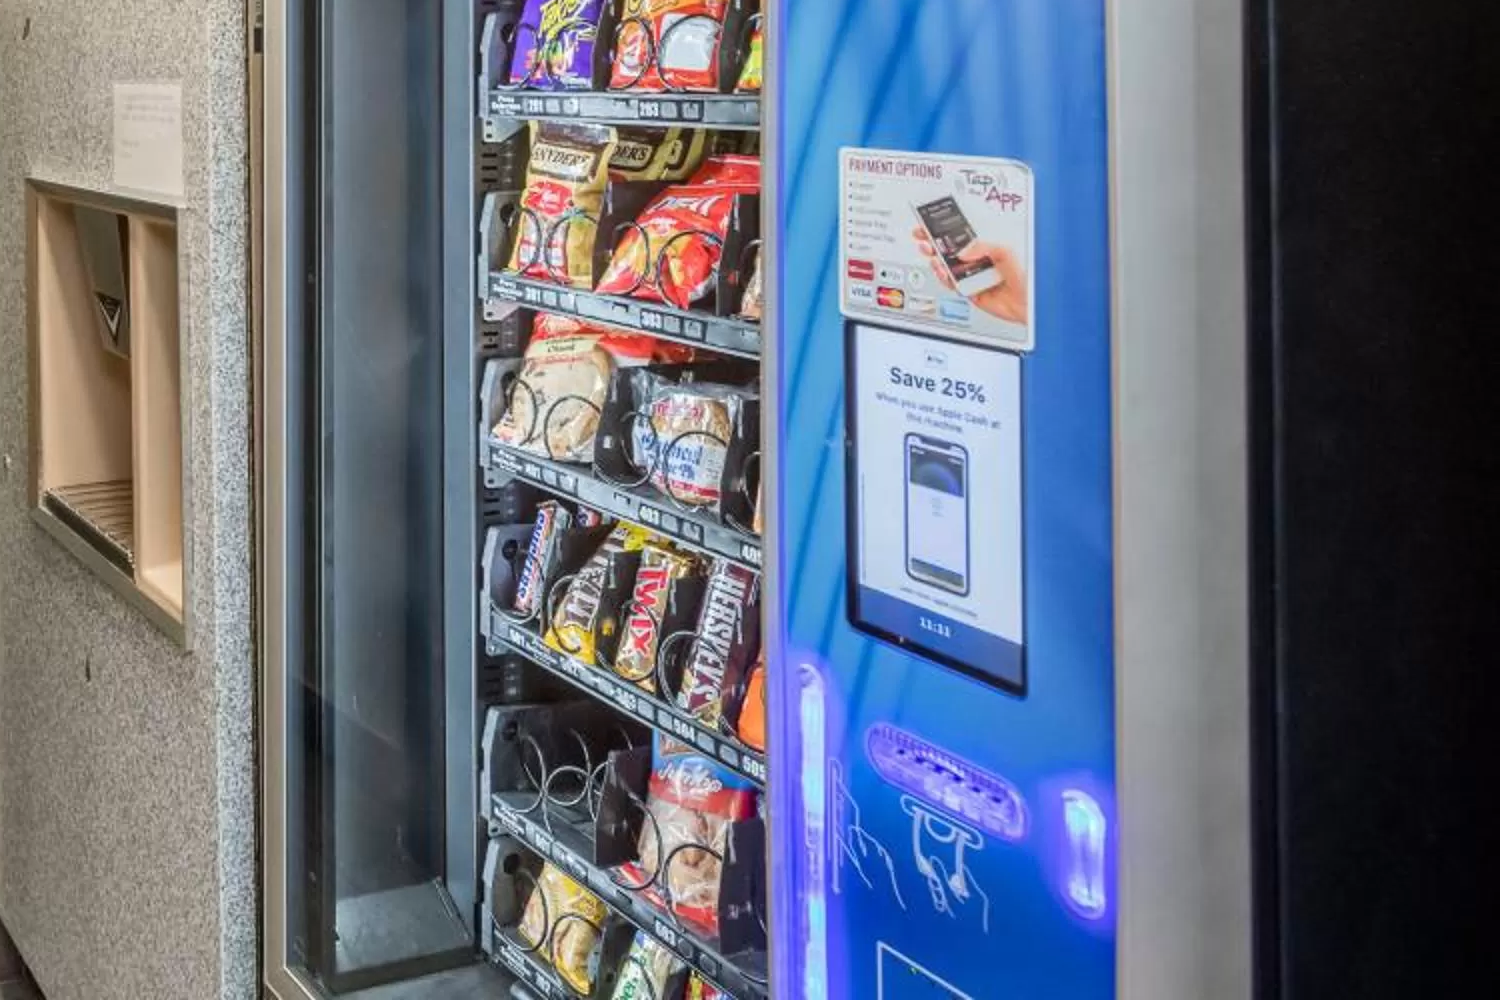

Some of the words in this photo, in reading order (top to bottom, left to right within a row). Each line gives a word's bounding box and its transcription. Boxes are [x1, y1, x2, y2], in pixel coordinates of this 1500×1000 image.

[849, 157, 893, 176] PAYMENT
[895, 161, 943, 181] OPTIONS
[959, 168, 994, 192] Tap
[889, 366, 936, 393] Save
[941, 377, 986, 404] 25%
[626, 568, 670, 657] TWIX
